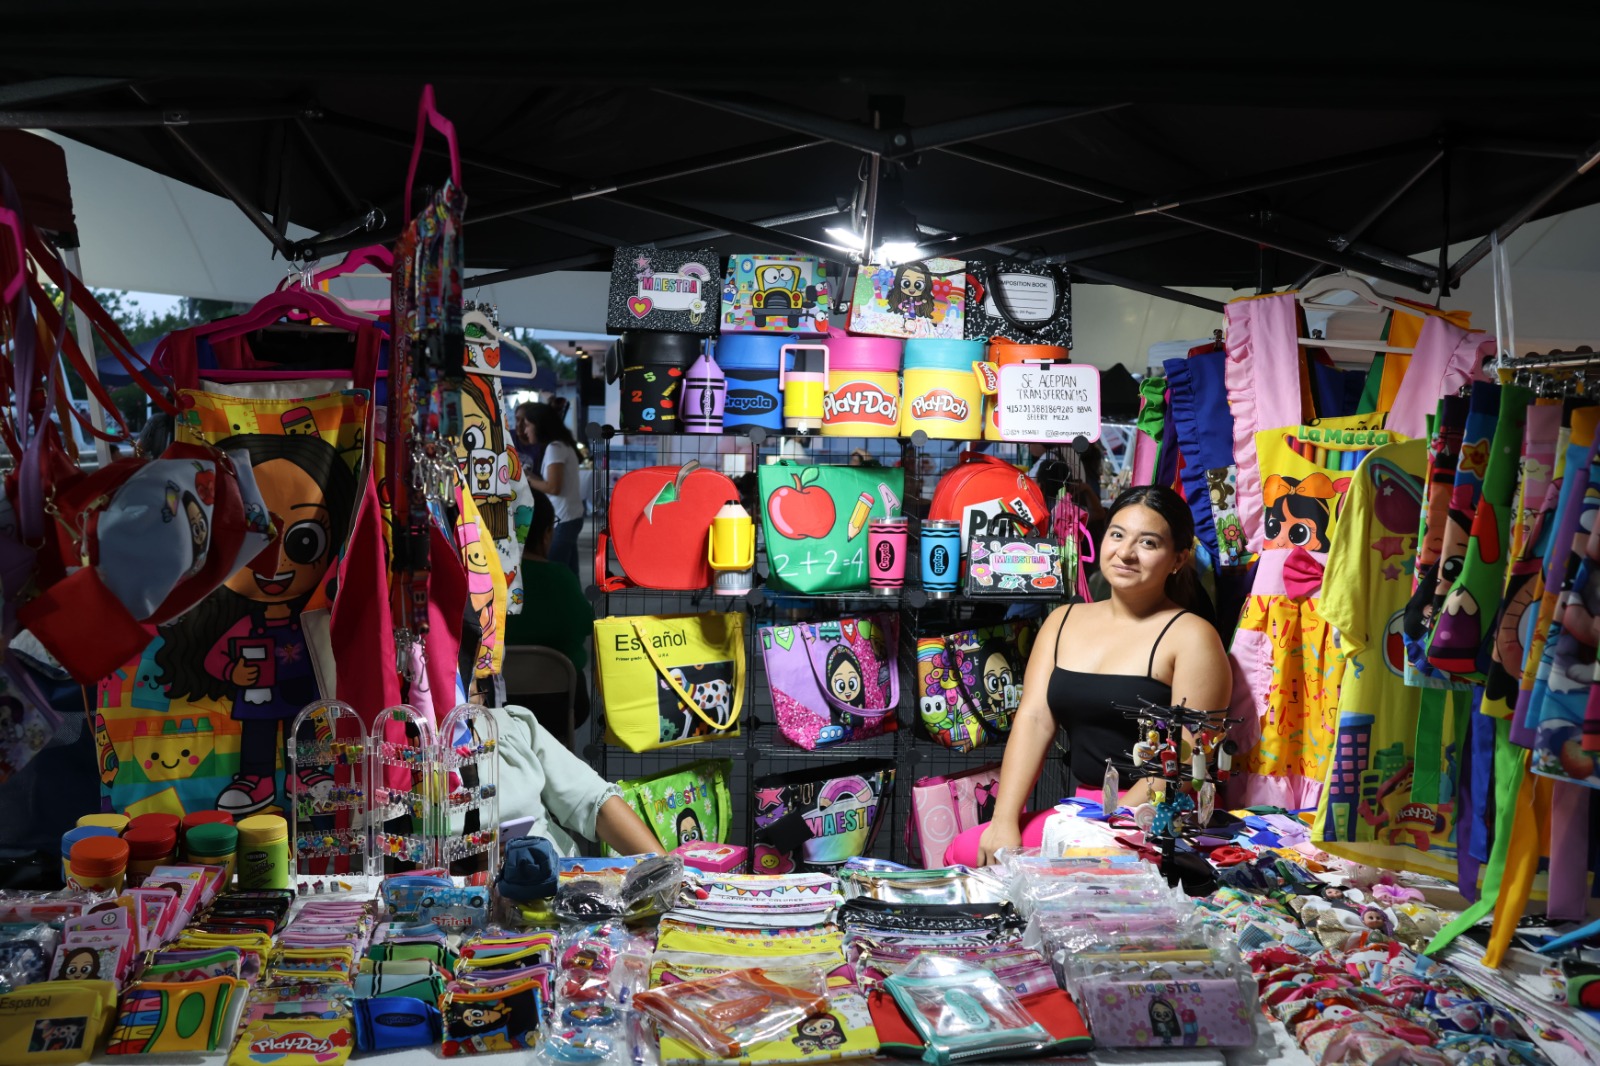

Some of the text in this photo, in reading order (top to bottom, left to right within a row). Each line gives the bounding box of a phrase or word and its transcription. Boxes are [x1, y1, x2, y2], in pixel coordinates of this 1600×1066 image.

[642, 277, 697, 293] MAESTRA
[980, 361, 997, 390] Play-Doh
[1022, 374, 1077, 388] SE ACEPTAN
[631, 390, 643, 402] 2
[823, 391, 897, 422] Play-Doh
[912, 395, 967, 418] Play-Doh
[642, 408, 656, 421] 6
[1298, 425, 1389, 446] La Maeta
[878, 542, 891, 570] Crayola
[932, 547, 945, 574] Crayola
[994, 555, 1047, 564] MAESTRA
[615, 629, 687, 653] Esañol
[654, 781, 707, 814] maestra
[805, 805, 878, 839] MAESTR
[1127, 981, 1201, 995] maestra
[0, 996, 52, 1011] Español
[254, 1037, 329, 1052] Play-Doh
